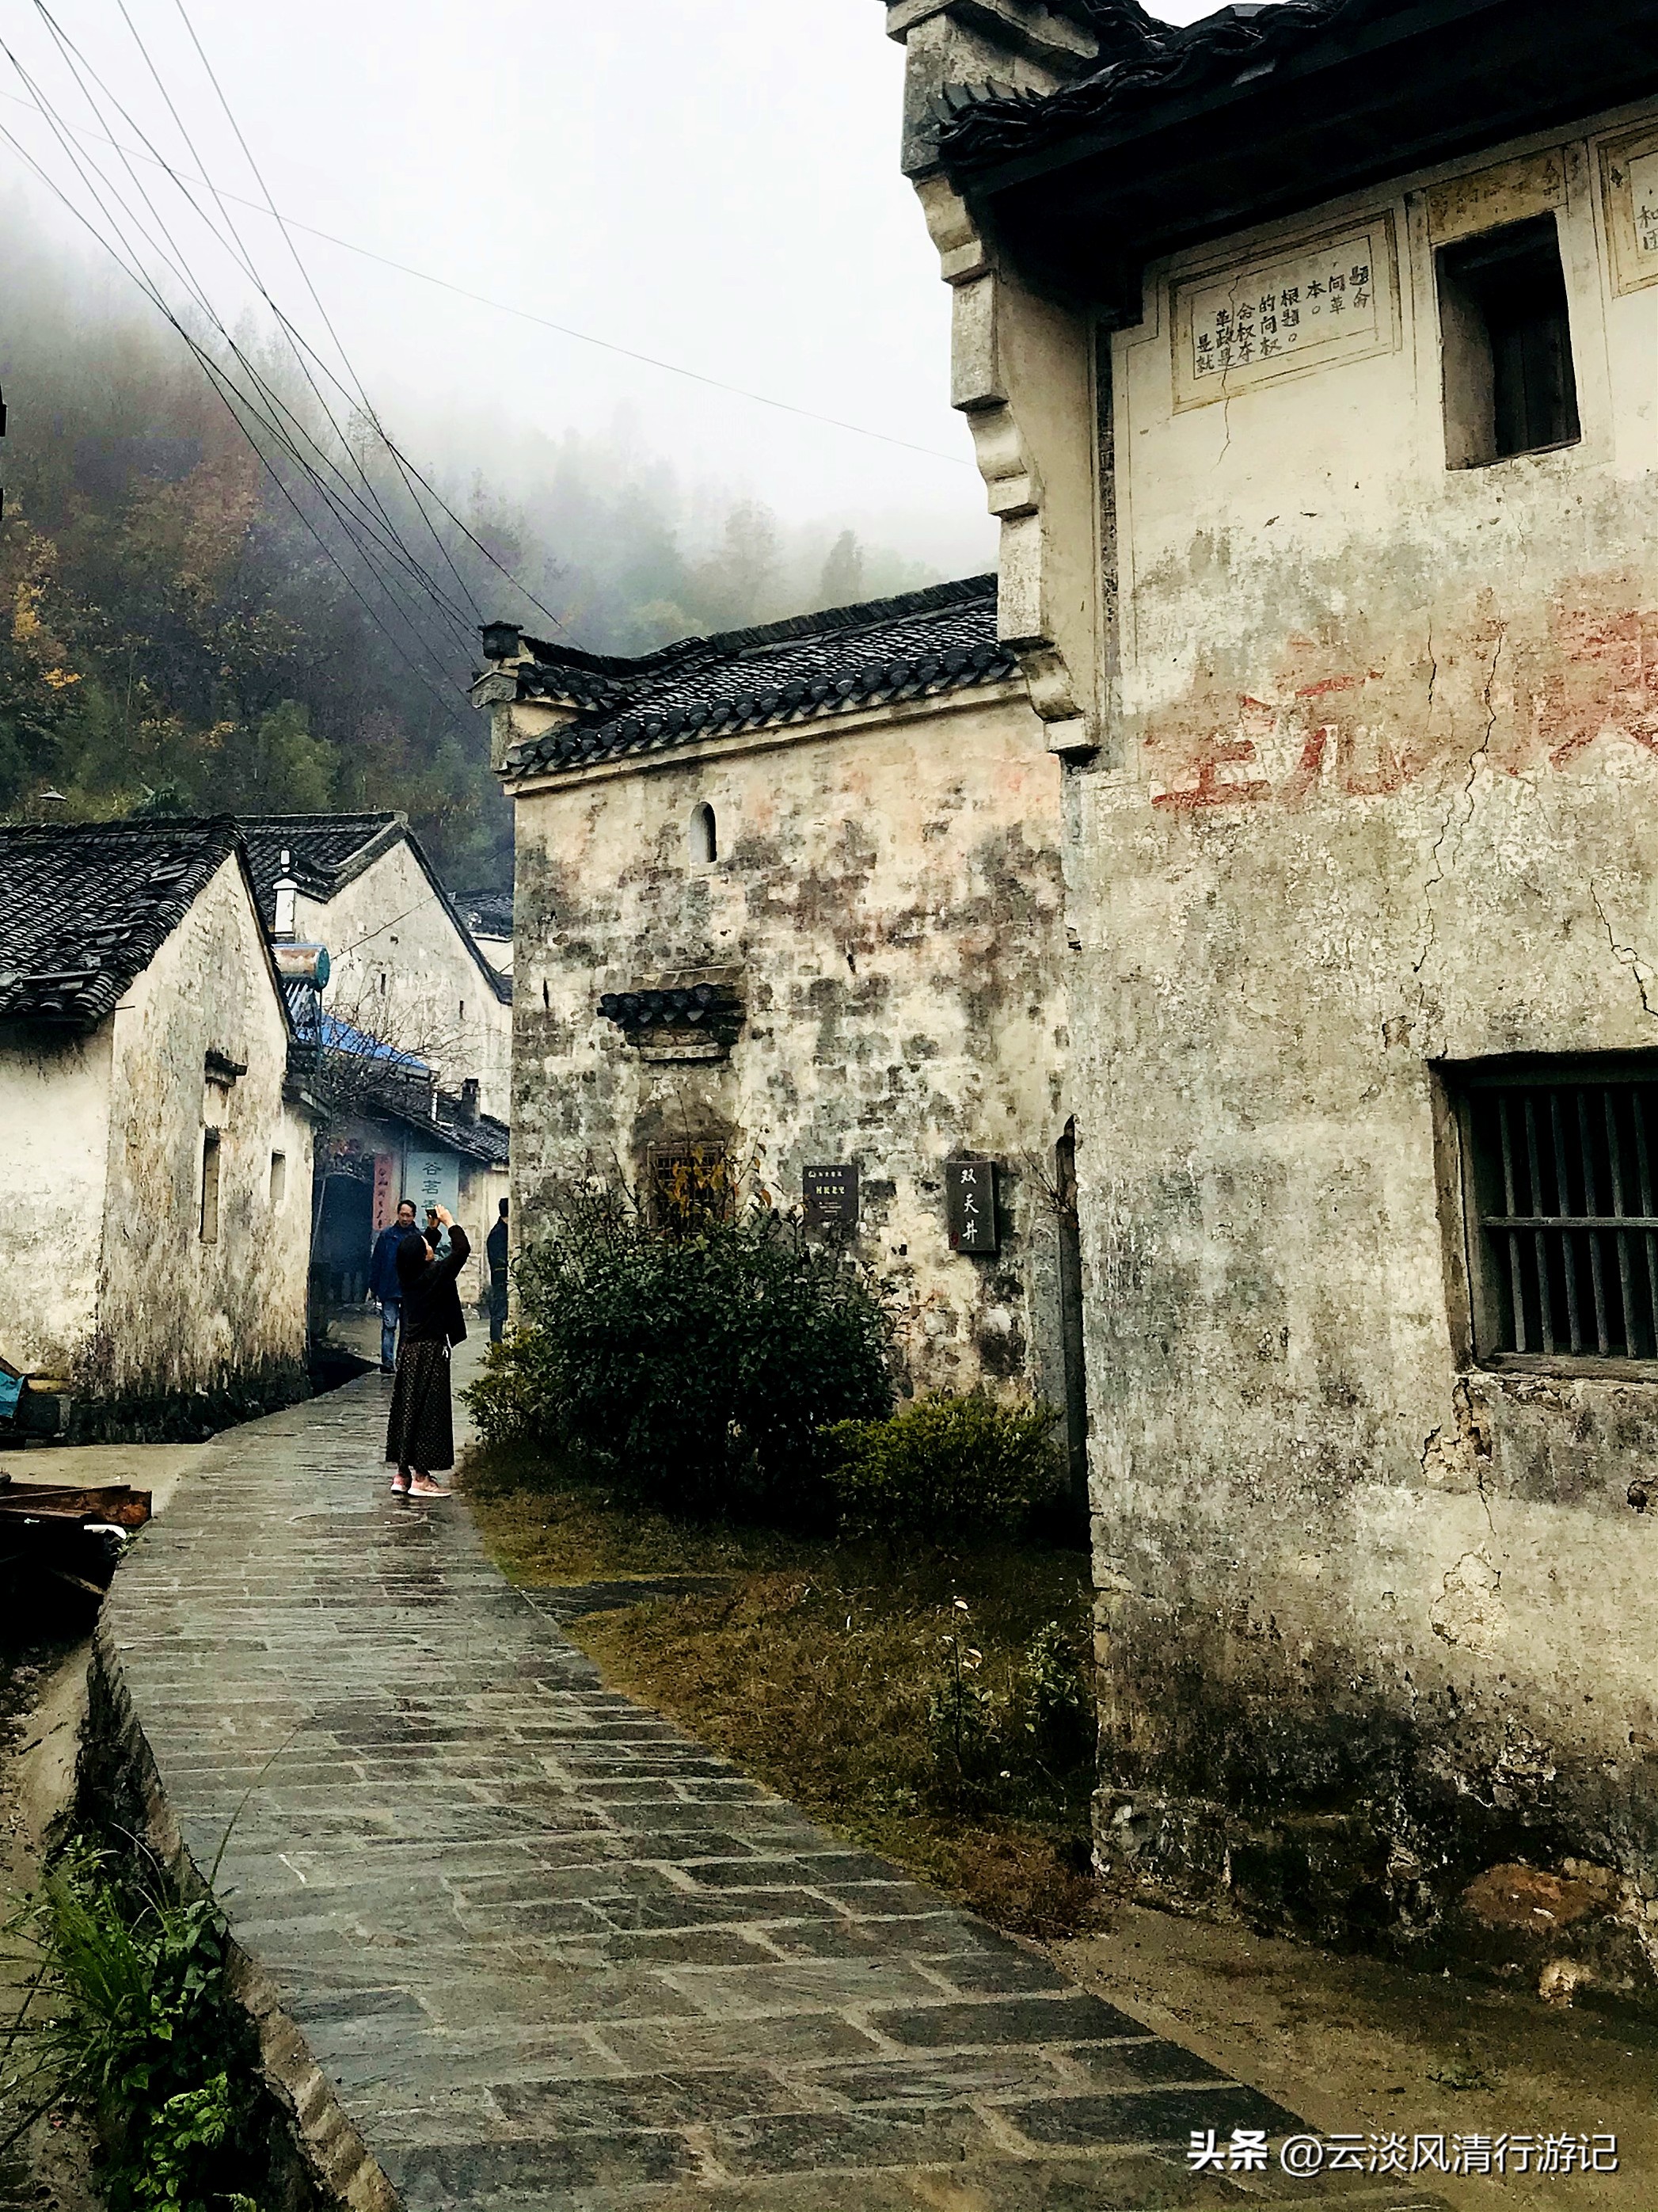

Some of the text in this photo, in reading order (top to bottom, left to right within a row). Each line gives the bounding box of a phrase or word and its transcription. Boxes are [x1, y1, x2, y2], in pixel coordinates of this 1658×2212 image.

[1216, 265, 1369, 327] 革命的根本问题
[960, 1167, 979, 1244] 双天井
